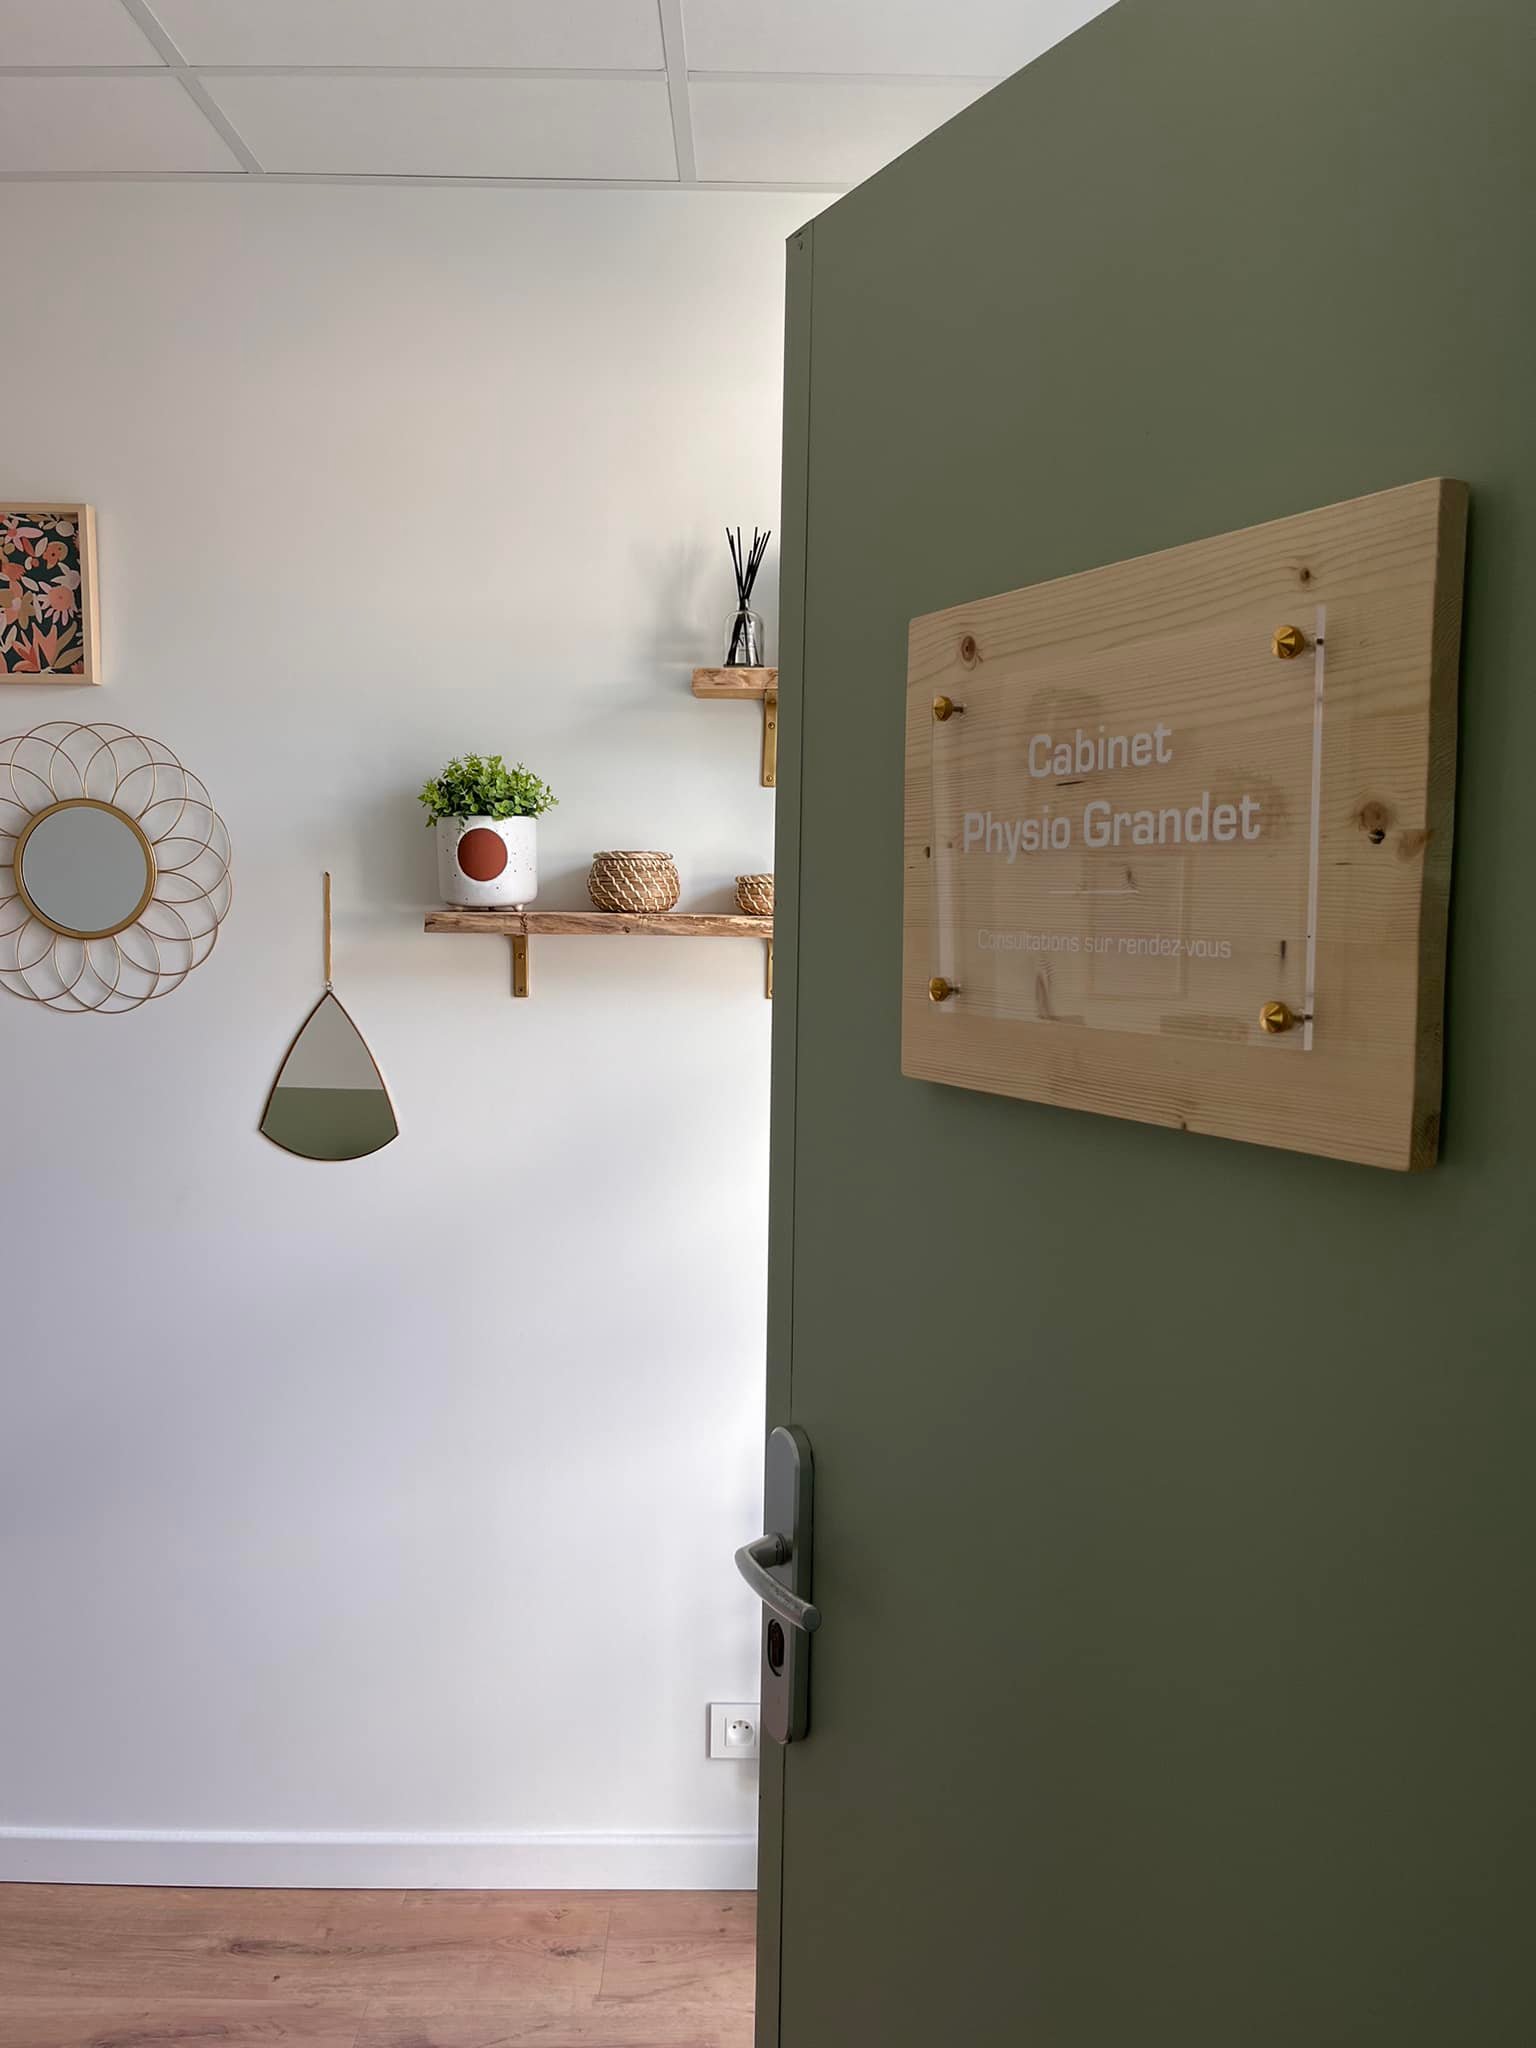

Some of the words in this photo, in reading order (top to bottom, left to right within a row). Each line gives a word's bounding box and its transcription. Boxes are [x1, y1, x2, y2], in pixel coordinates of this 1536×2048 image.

[1027, 723, 1174, 778] Cabinet
[962, 805, 1071, 865] Physio
[1083, 791, 1262, 849] Grandet
[977, 928, 1079, 953] Consultations
[1084, 935, 1112, 953] sur
[1118, 935, 1232, 959] rendez-vous
